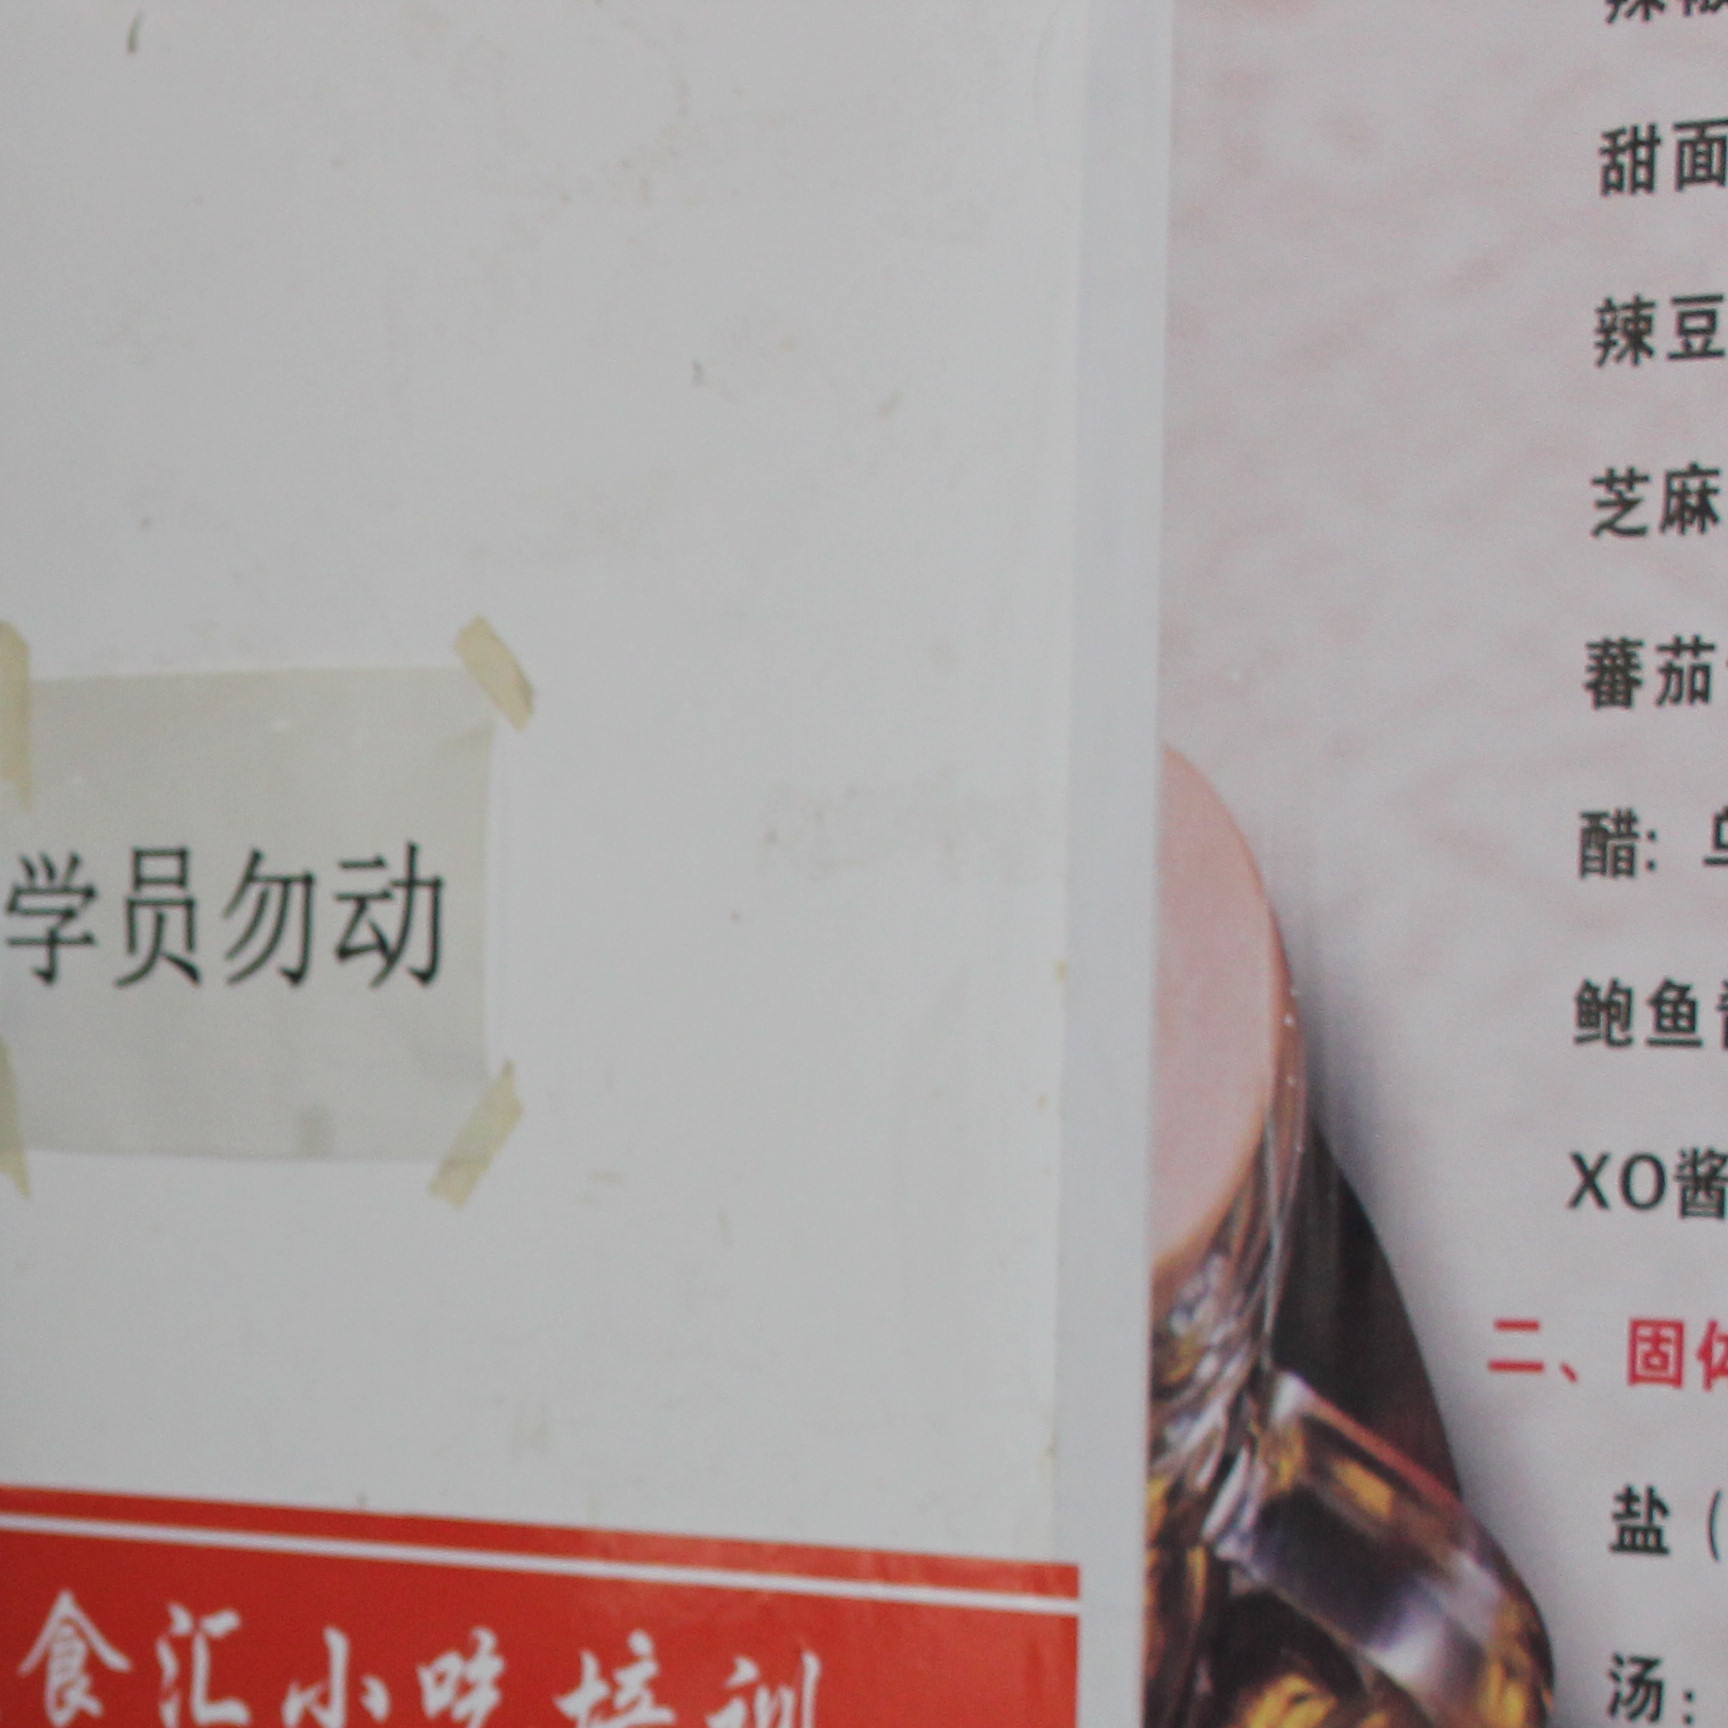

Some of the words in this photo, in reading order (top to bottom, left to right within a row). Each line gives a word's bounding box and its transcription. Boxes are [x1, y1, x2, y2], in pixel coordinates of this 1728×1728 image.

[1591, 463, 1721, 538] 芝麻
[5, 841, 444, 989] 学员勿动
[1574, 976, 1728, 1051] 鲍鱼
[1566, 1147, 1728, 1220] XO酱
